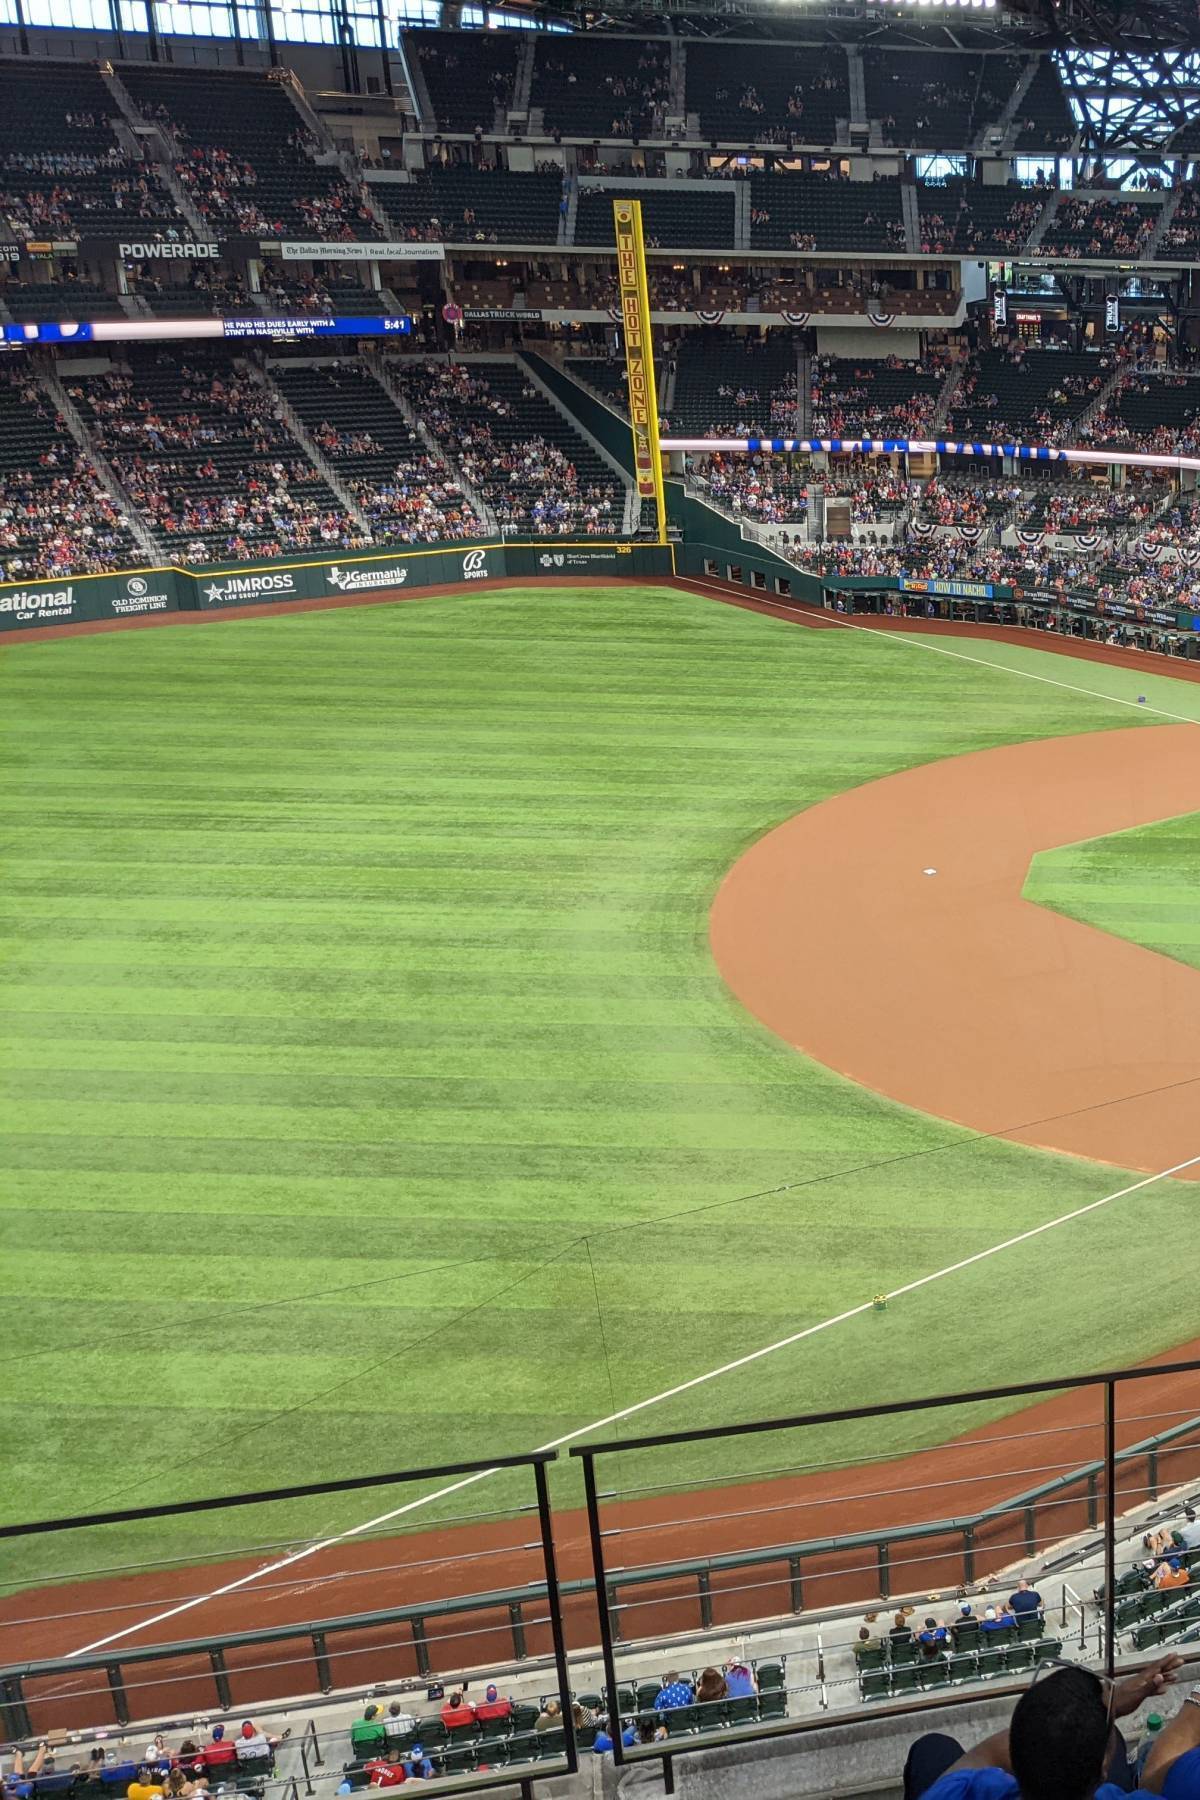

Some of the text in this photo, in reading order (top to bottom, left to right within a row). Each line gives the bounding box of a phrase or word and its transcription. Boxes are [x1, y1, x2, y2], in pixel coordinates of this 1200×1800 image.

[119, 243, 219, 259] POWERADE
[464, 310, 540, 319] DALLAS TRUCK WORLD
[995, 296, 1003, 320] TRULY
[236, 321, 253, 329] PAID
[256, 327, 295, 335] NASHVILLE
[384, 320, 405, 330] 5:41
[621, 236, 646, 423] THE HOT ZONE
[350, 567, 406, 582] Germania
[464, 570, 488, 580] SPORTS
[933, 581, 951, 594] HOW
[952, 583, 961, 595] TO
[112, 594, 168, 607] OLD DOMINION
[239, 591, 260, 600] GROUP
[16, 606, 73, 620] Car Rental
[115, 601, 167, 614] FREIGHT LINE
